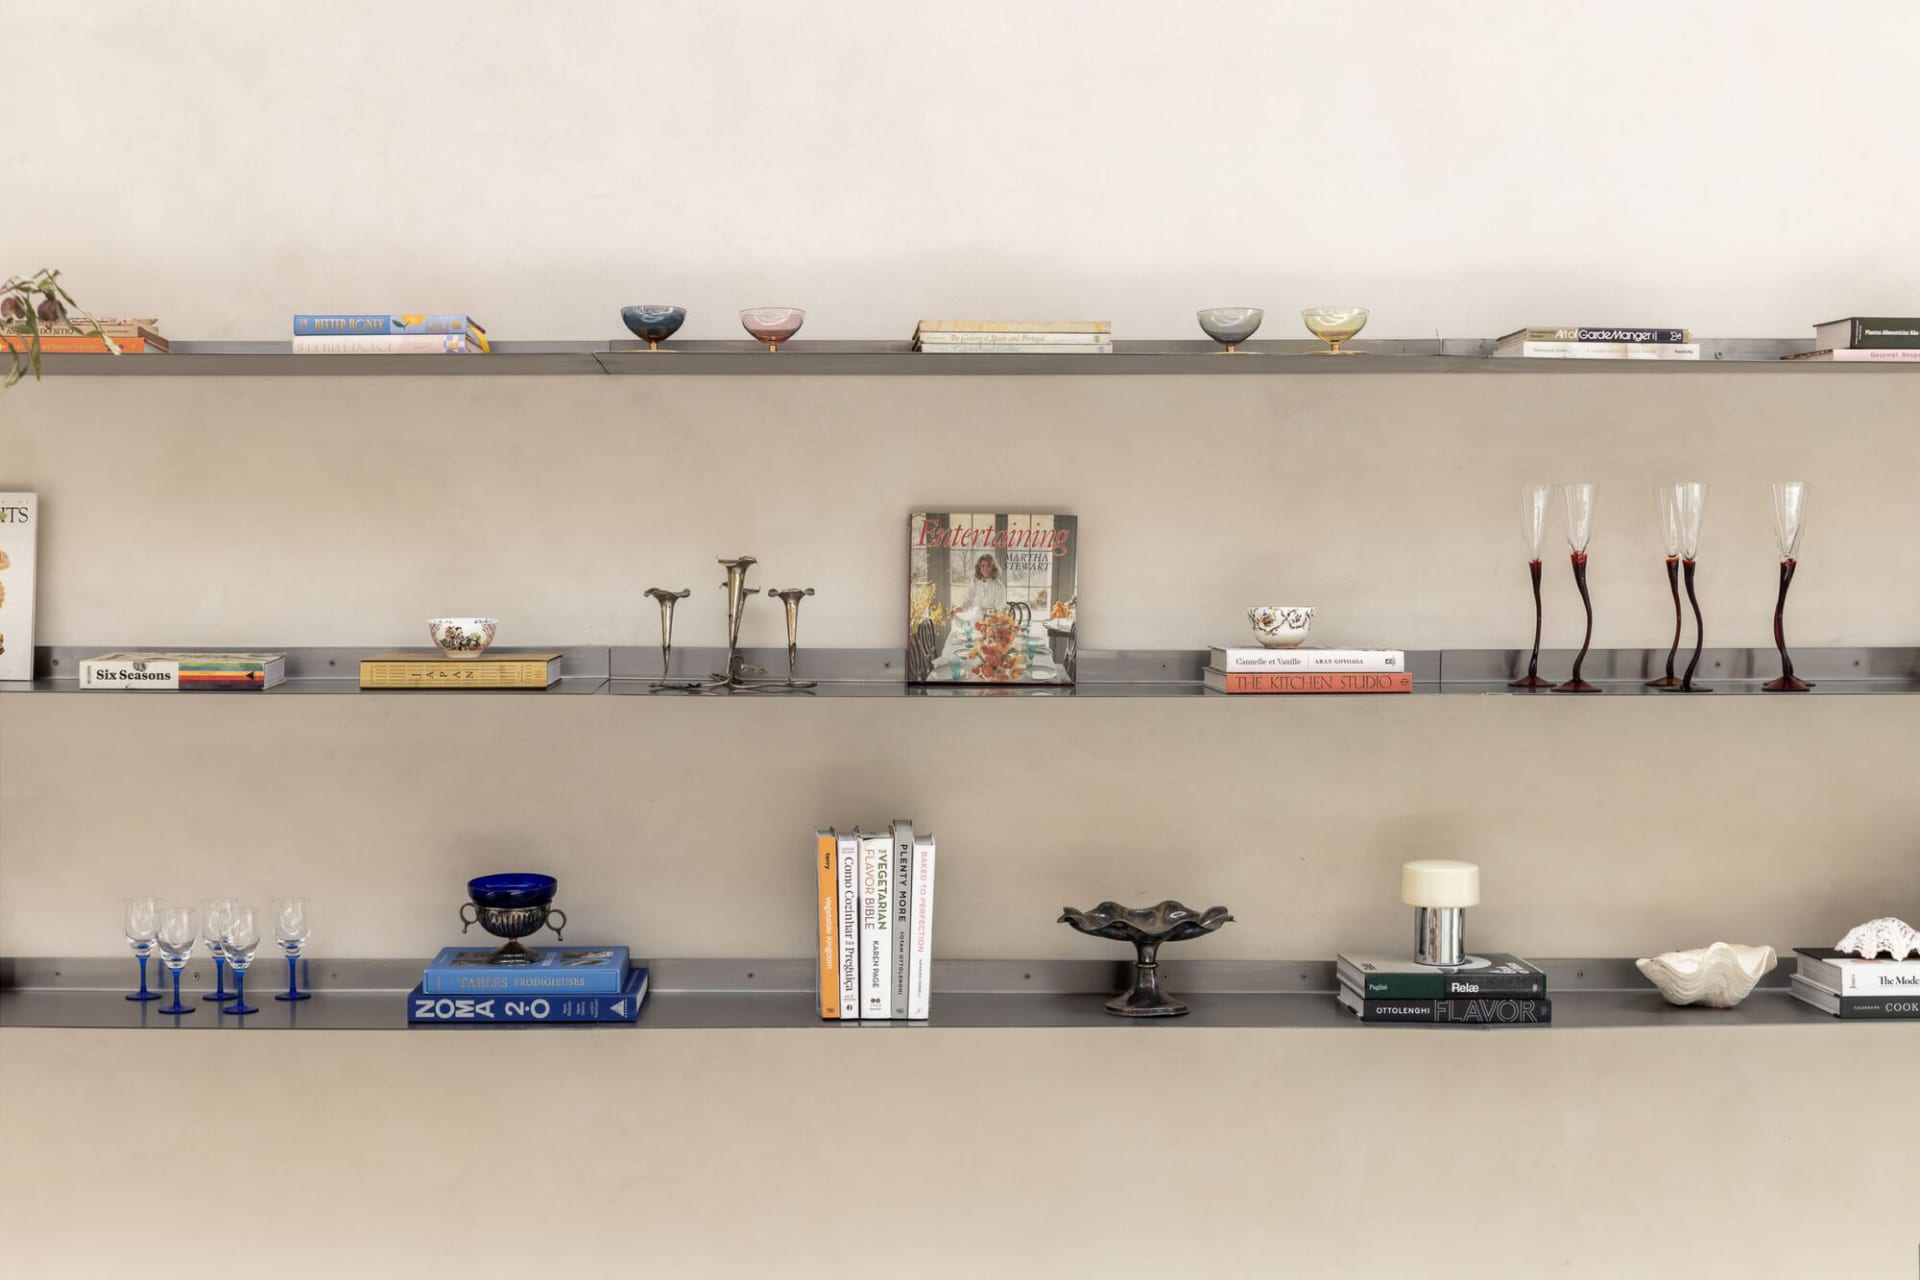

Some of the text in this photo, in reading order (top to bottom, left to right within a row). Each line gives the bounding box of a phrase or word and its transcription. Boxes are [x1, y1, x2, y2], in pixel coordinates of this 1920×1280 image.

[314, 318, 346, 330] BITTER
[349, 318, 385, 330] HONEY
[917, 518, 1071, 557] Entertaining
[1004, 552, 1049, 563] MARTHA
[1003, 562, 1051, 571] STEWART
[1235, 657, 1301, 666] Cannelle et Vanille
[96, 669, 117, 681] Six
[119, 669, 171, 681] Seasons
[411, 671, 475, 679] JAPAN
[1235, 674, 1393, 690] THE KITCHEN STUDIO
[843, 856, 855, 889] Como
[864, 849, 875, 930] FLAVOR BIBLE
[898, 844, 909, 922] PLENTY MORE
[877, 854, 888, 930] VEGETARIAN
[917, 851, 928, 953] BAKED TO PERFECTION
[844, 890, 856, 939] Cozinhar
[843, 947, 856, 992] Preguiça
[871, 940, 880, 988] KAREN PAGE
[460, 975, 585, 988] TABLES PRODIGIEUSES
[1451, 982, 1480, 993] Relæ
[1879, 975, 1895, 985] The
[415, 998, 495, 1019] NOMA
[1376, 1006, 1431, 1015] OTTOLENGHI
[1434, 999, 1538, 1023] FLAVOR
[1885, 1001, 1920, 1013] COOK
